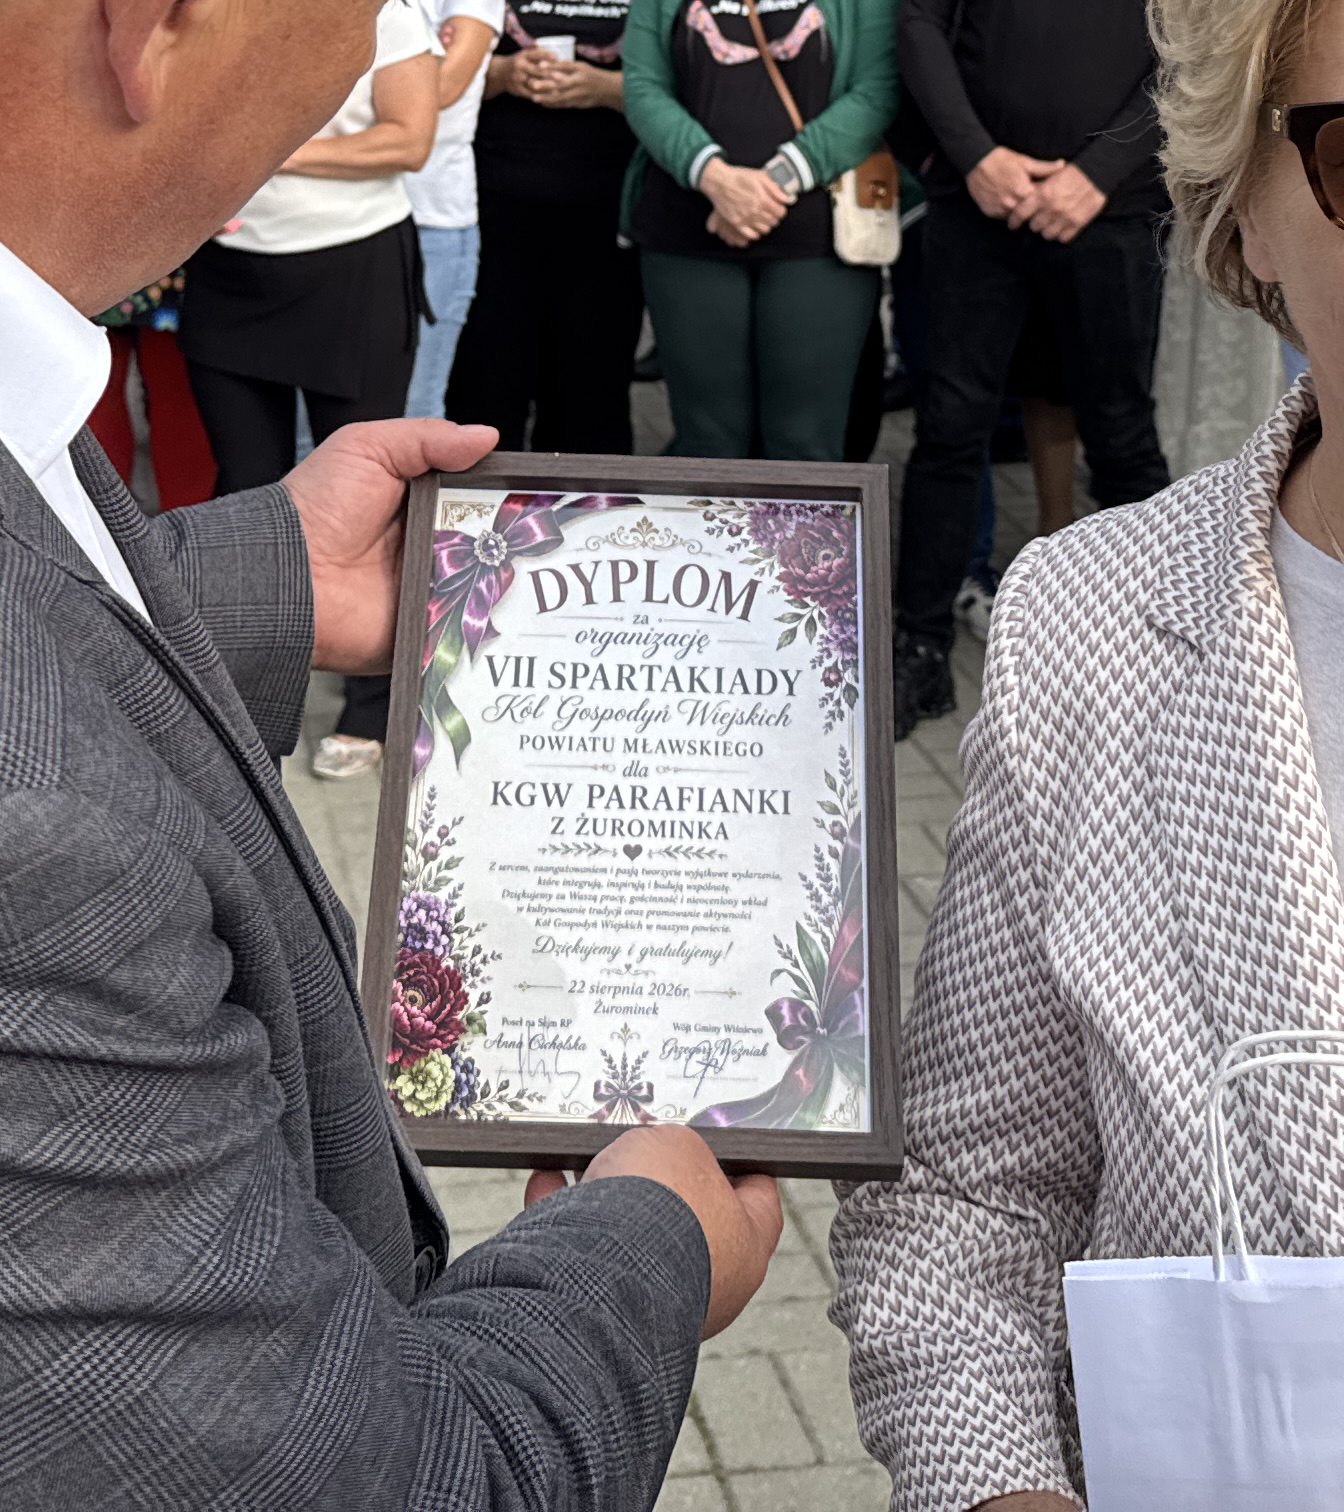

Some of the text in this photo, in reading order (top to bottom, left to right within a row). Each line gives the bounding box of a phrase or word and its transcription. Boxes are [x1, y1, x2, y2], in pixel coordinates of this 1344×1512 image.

[527, 559, 762, 622] DYPLOM
[632, 613, 649, 625] za
[575, 627, 711, 659] organizację
[484, 654, 803, 697] VII SPARTAKIADY
[482, 694, 792, 737] Kół Gospodyń Wiejskich
[519, 735, 764, 757] POWIATU MŁAWSKIEGO
[622, 760, 649, 777] dla
[490, 780, 792, 816] KGW PARAFIANKI
[550, 812, 729, 840] Z ŻUROMINKA
[489, 862, 496, 871] Z
[532, 935, 733, 966] Dziękujemy i gratulujemy!
[568, 980, 691, 999] 22 sierpnia 2026r.
[594, 999, 659, 1015] Żurominek
[560, 1018, 572, 1027] RP
